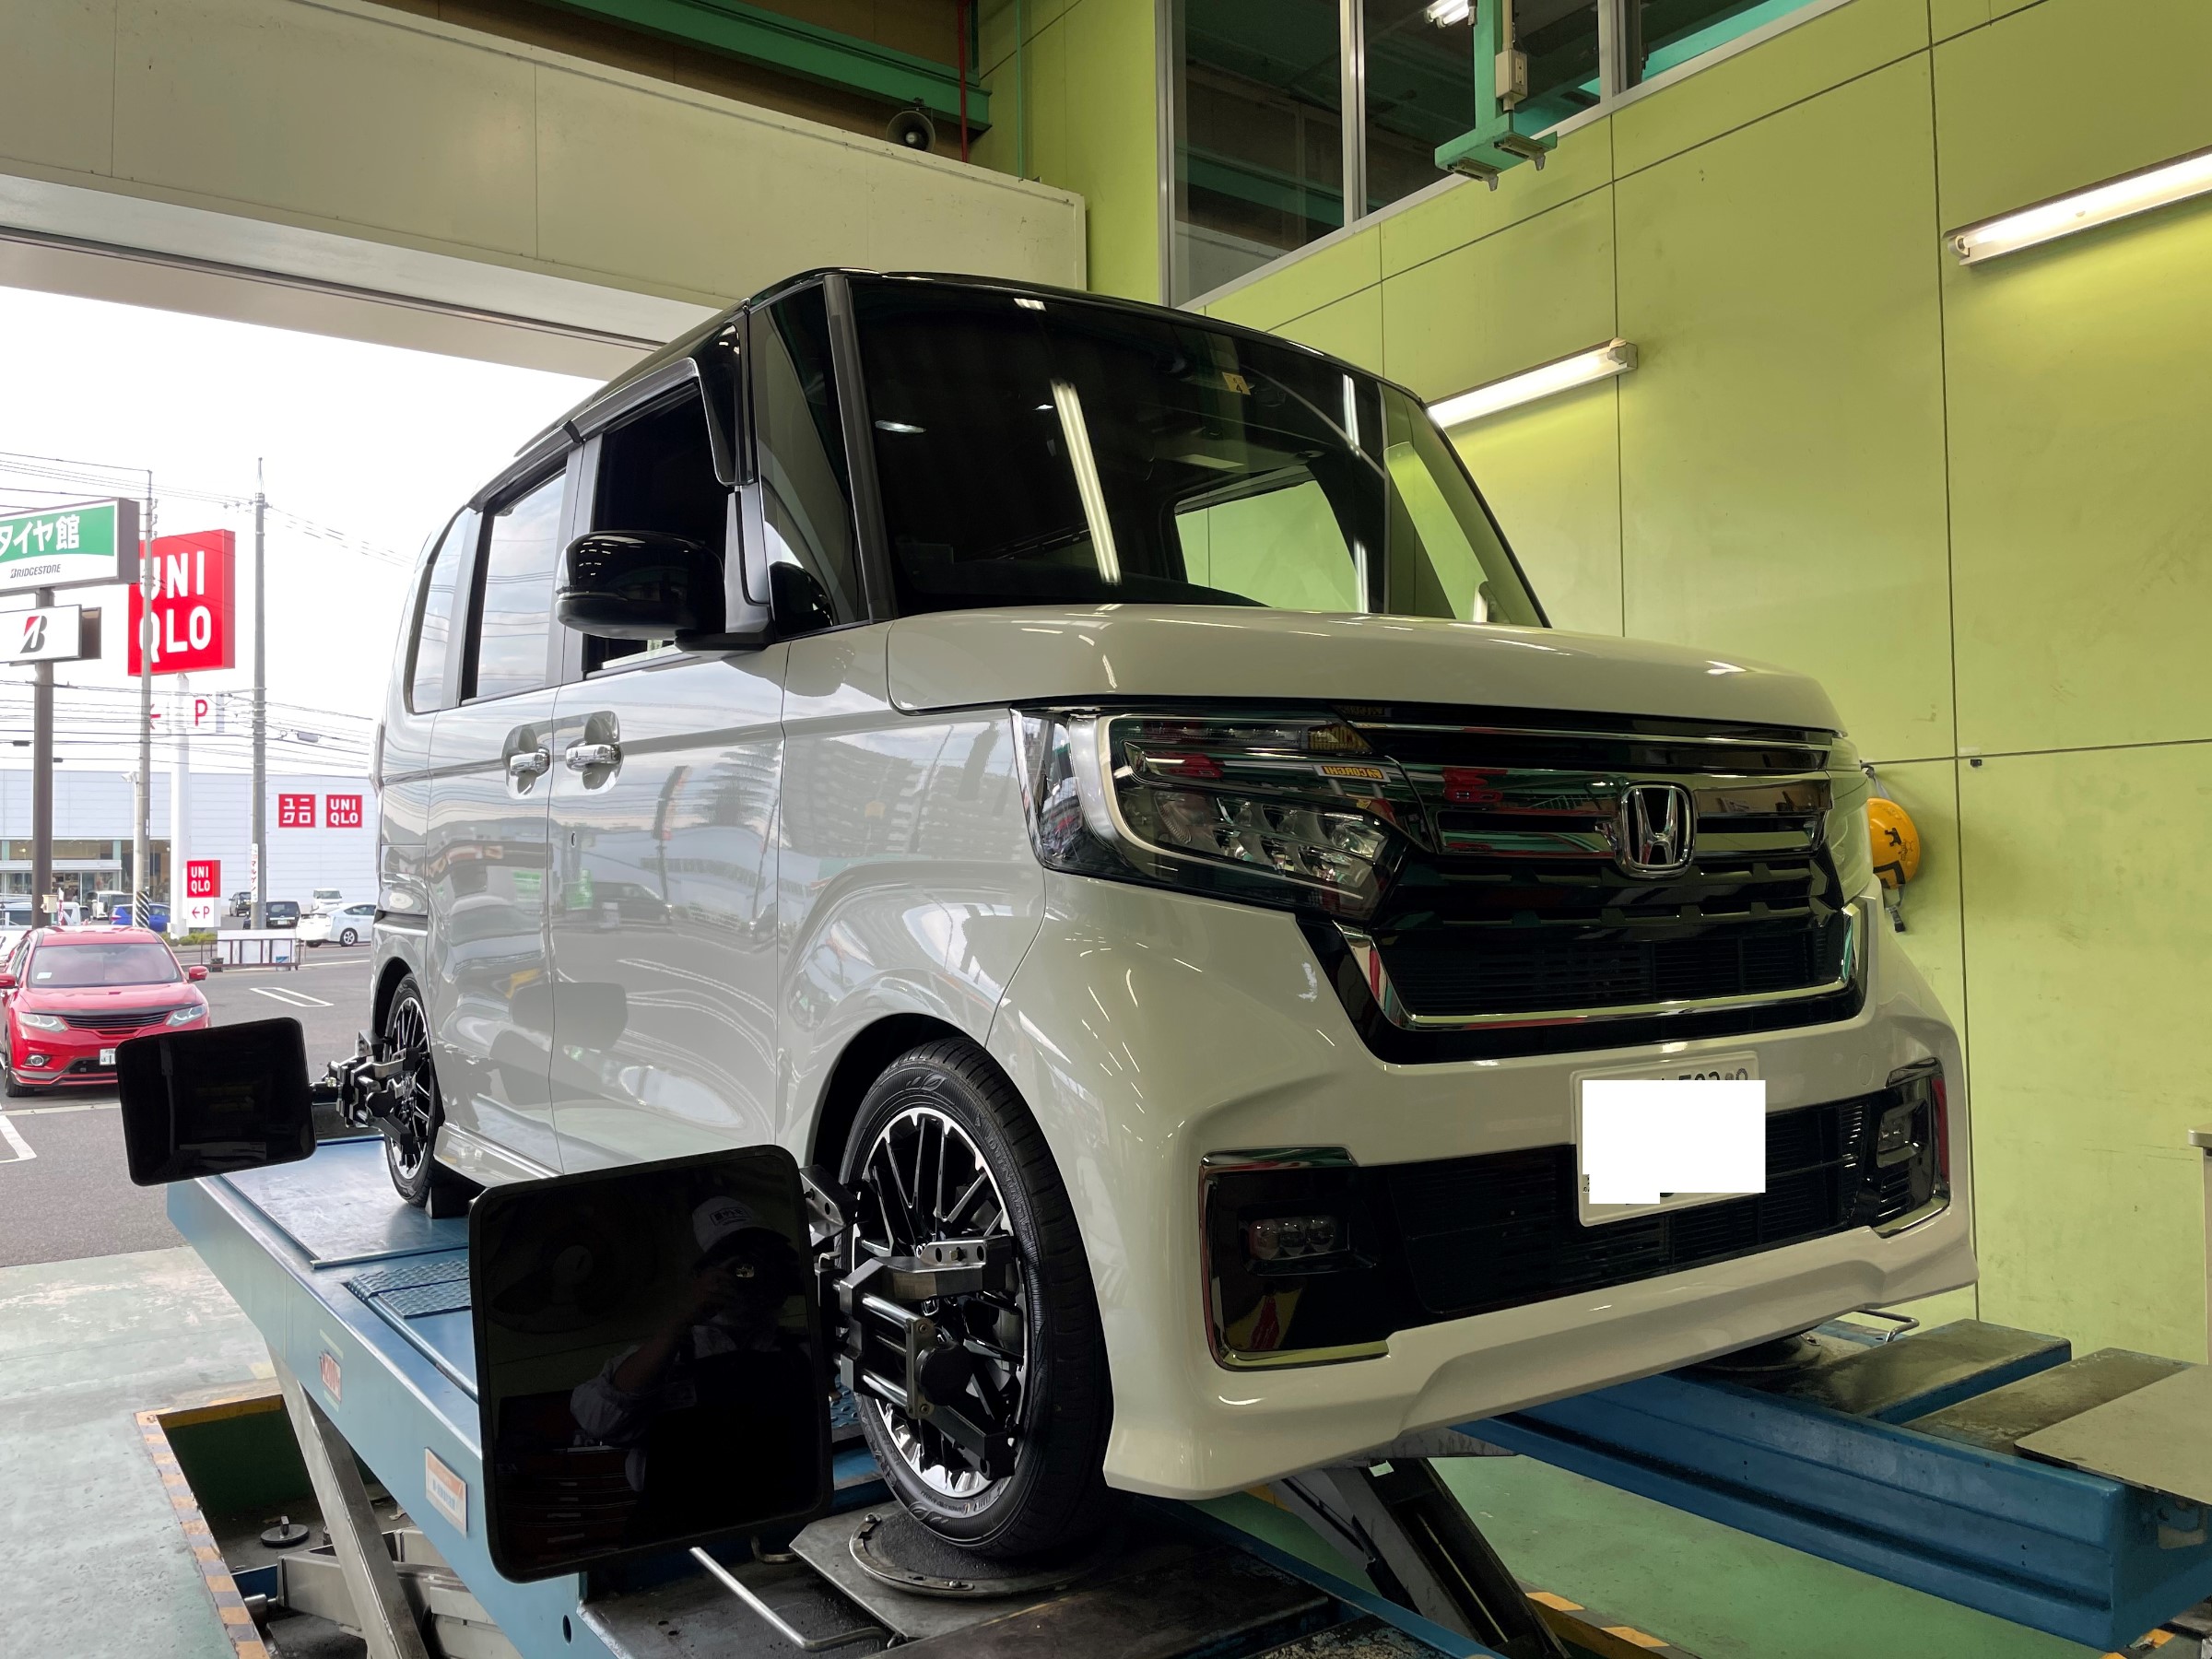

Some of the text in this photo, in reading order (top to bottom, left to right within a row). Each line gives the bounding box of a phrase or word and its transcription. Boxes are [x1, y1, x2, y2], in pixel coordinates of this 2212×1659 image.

[10, 563, 62, 579] BRIDGESTONE
[139, 550, 205, 601] UNI
[138, 606, 212, 664] QLO
[194, 699, 208, 727] P
[283, 797, 312, 810] ユニ
[330, 798, 357, 811] UNI
[282, 811, 312, 824] クロ
[330, 812, 359, 826] QLO
[191, 865, 209, 878] UNI
[191, 879, 211, 894] QLO
[203, 905, 210, 919] P
